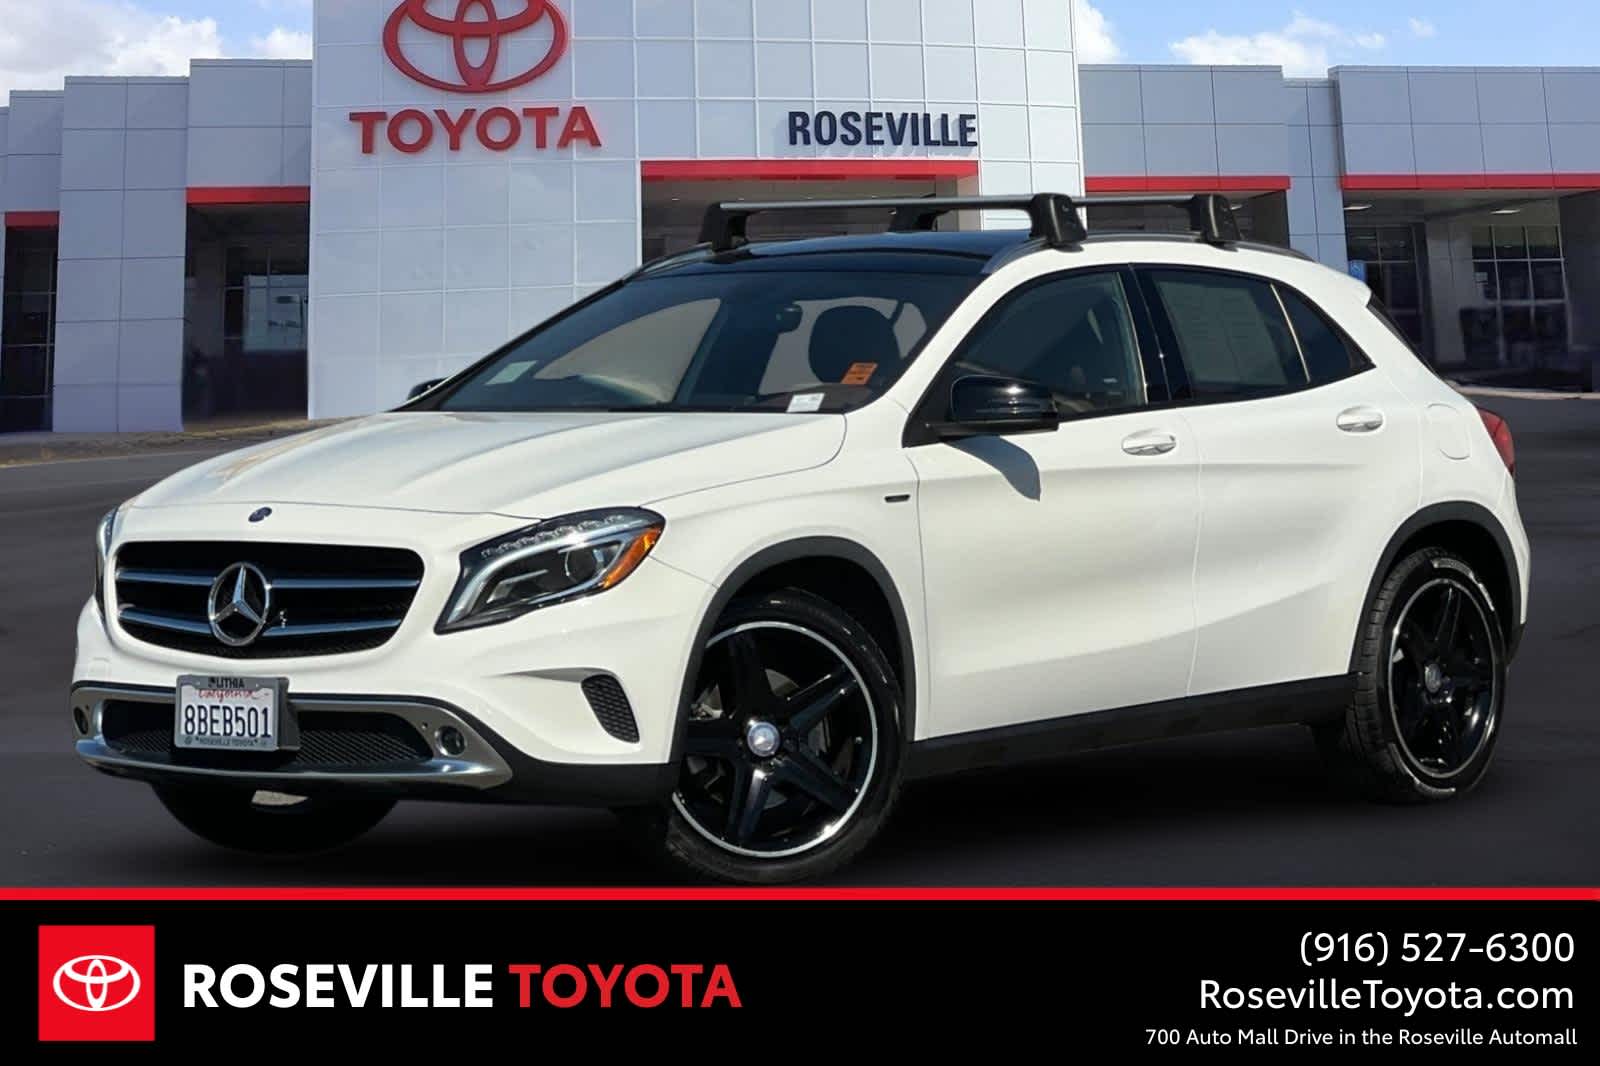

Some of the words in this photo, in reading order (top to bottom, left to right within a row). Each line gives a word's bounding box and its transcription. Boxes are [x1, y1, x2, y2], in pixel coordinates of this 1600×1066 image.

[350, 106, 602, 154] TOYOTA
[788, 111, 978, 147] ROSEVILLE
[216, 677, 245, 689] LITHIA
[184, 704, 272, 738] 8BEB501
